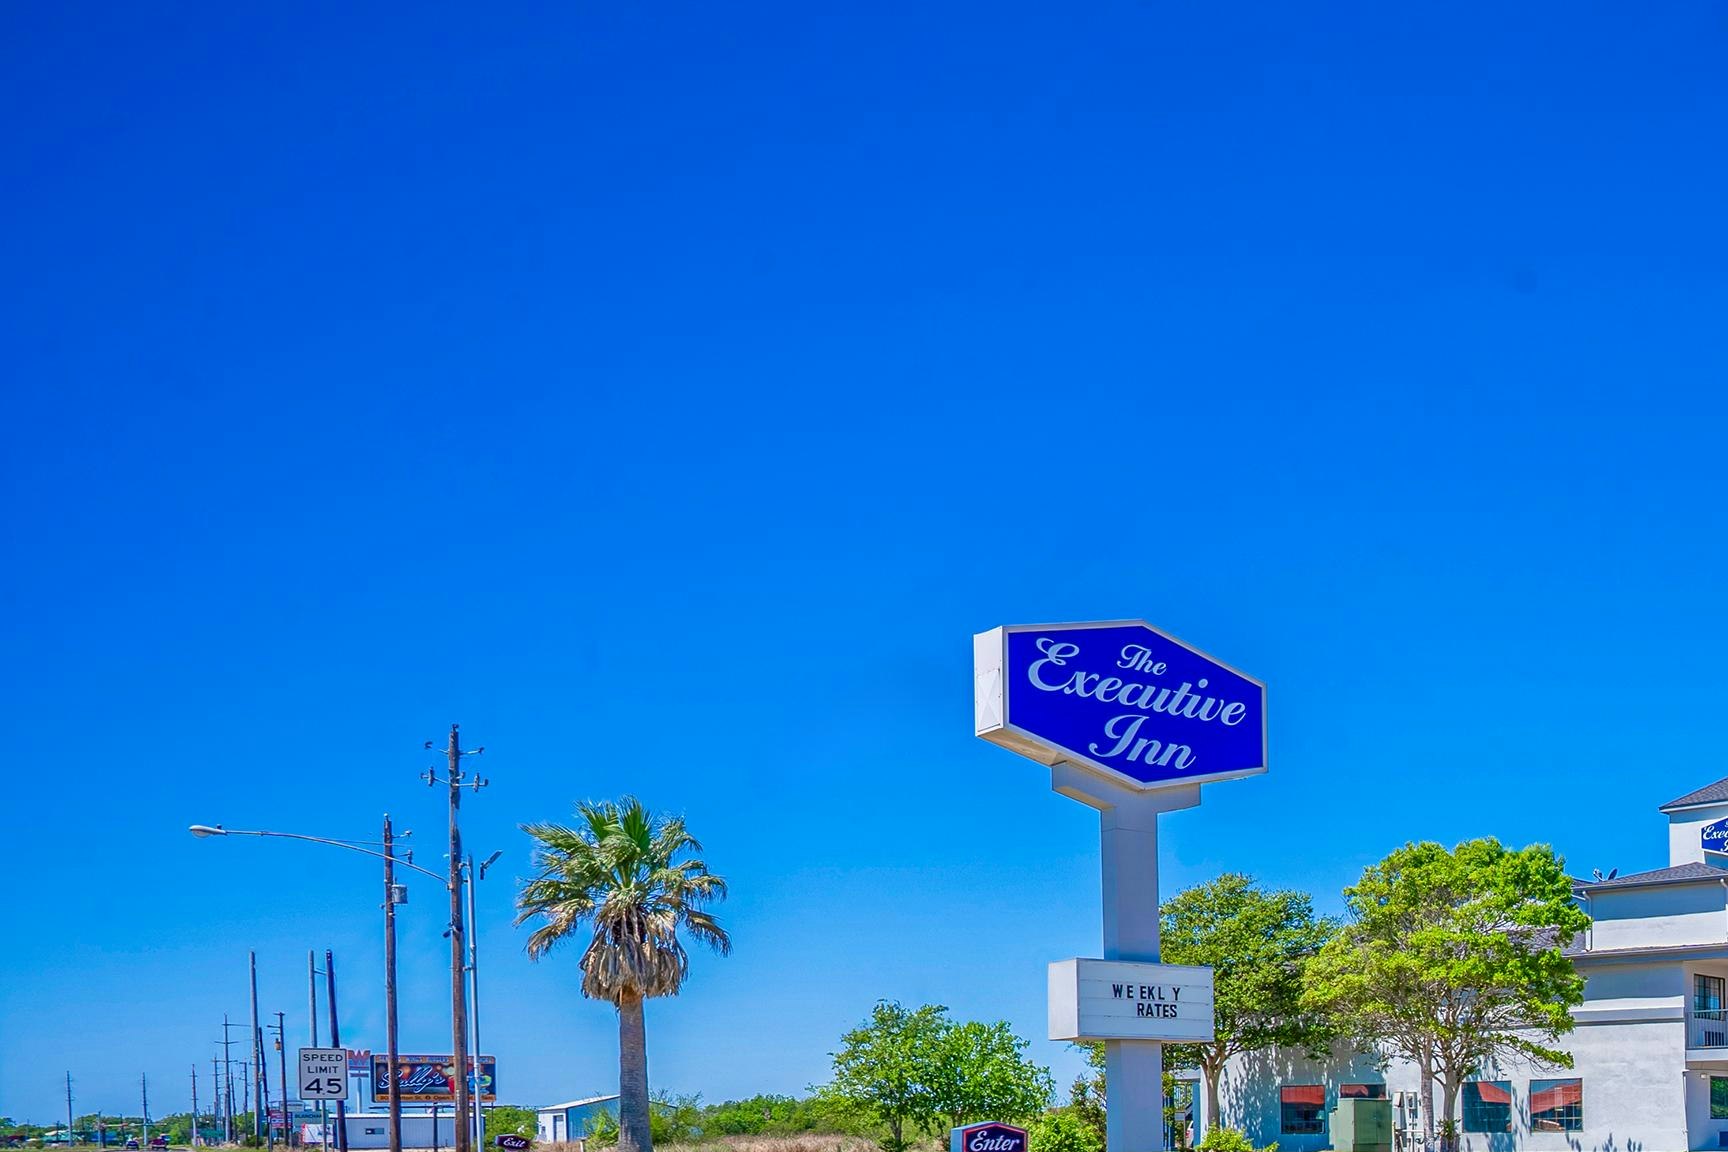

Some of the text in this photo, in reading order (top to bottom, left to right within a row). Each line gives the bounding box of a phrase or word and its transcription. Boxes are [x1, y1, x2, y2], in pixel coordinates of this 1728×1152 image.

[1116, 644, 1167, 676] The
[1028, 637, 1247, 726] Executive
[1088, 714, 1196, 770] Inn
[1137, 1003, 1178, 1018] RATES
[303, 1053, 344, 1062] SPEED
[304, 1078, 342, 1094] 45
[503, 1137, 526, 1148] Exit
[969, 1130, 1020, 1152] Enter
